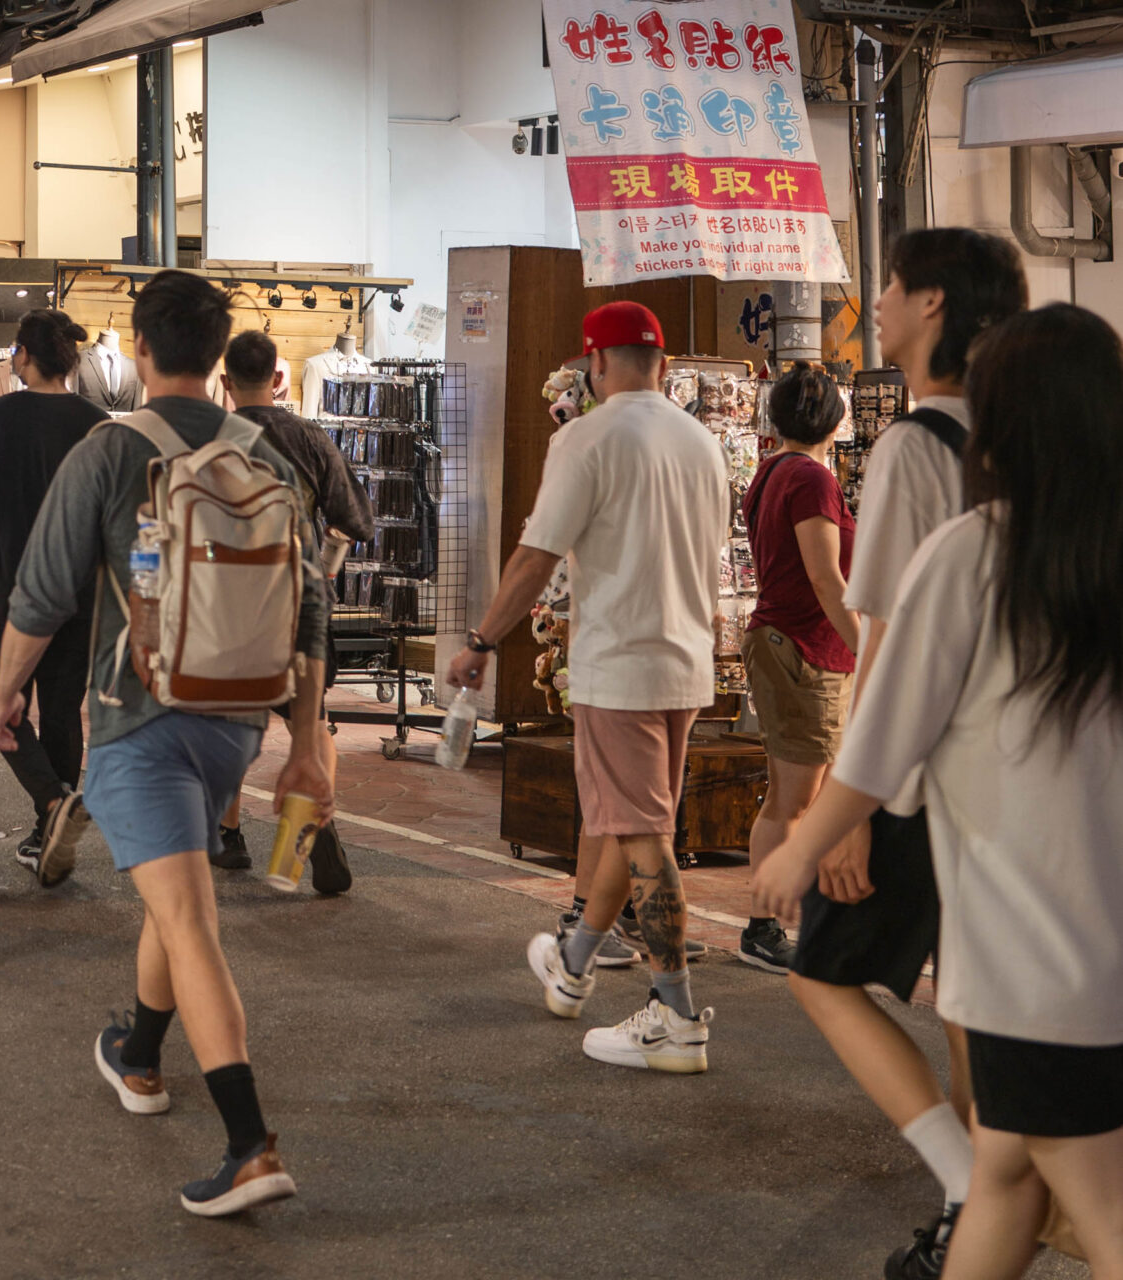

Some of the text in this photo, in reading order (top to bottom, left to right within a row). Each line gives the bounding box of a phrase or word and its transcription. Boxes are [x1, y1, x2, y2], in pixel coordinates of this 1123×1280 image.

[561, 10, 794, 76] 姓名貼紙
[579, 82, 802, 156] 卡通印章
[610, 164, 799, 201] 現場取件
[618, 216, 650, 234] 이름
[707, 215, 807, 235] 姓名は貼ります
[640, 241, 678, 254] Make
[708, 241, 764, 254] individual
[768, 243, 801, 253] name
[635, 257, 694, 273] stickers
[731, 259, 740, 272] it
[744, 260, 774, 274] right
